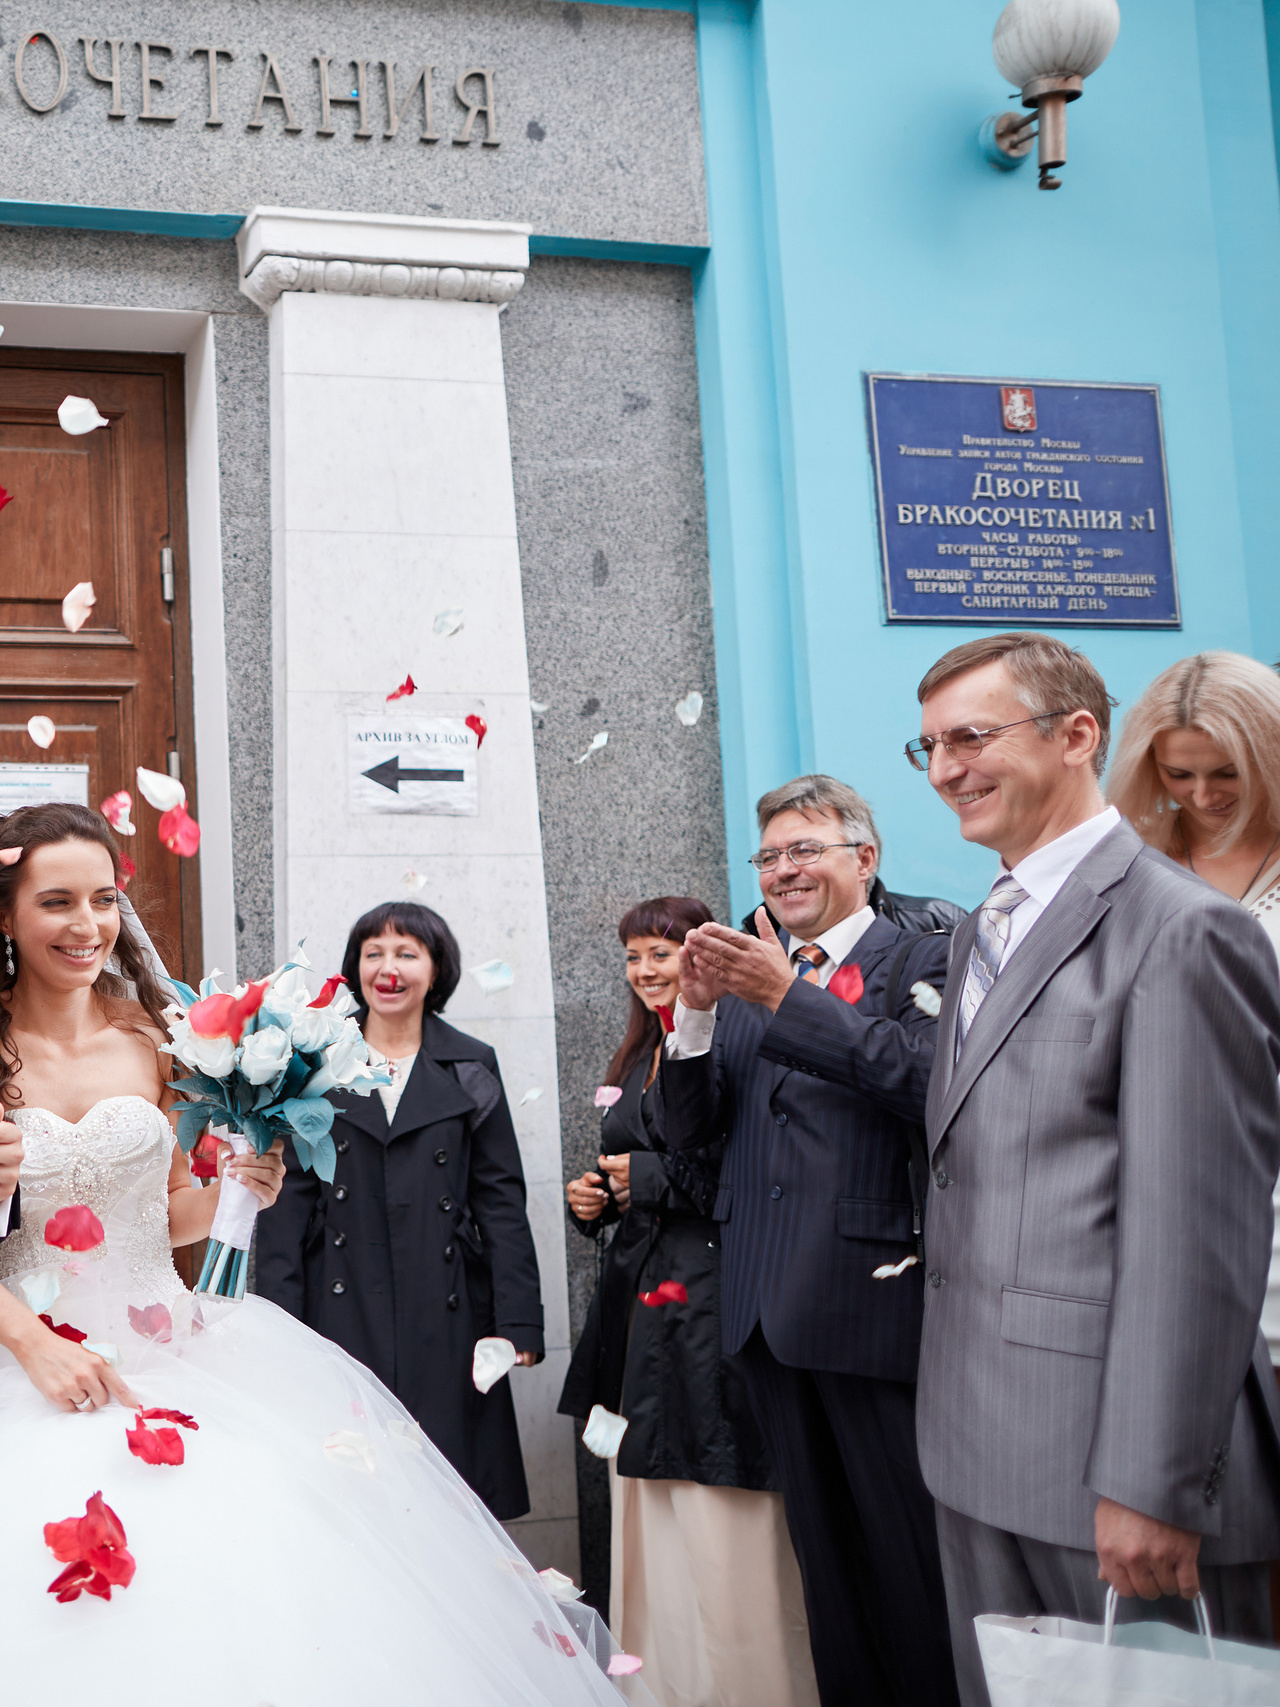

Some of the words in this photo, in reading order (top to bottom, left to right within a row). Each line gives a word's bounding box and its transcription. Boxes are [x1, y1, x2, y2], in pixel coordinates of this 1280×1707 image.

[897, 504, 1123, 530] БРАКОСОЧЕТАНИЯ
[981, 532, 1018, 543] ЧАСЫ
[1074, 572, 1157, 585] ПОНЕДЕЛЬНИК
[914, 580, 966, 593] ПЕРВЫЙ
[973, 583, 1030, 596] ВТОРНИК
[1037, 583, 1096, 597] КАЖДОГО
[961, 595, 1059, 610] САНИТАРНЫЙ
[1067, 598, 1108, 611] ДЕНЬ
[355, 732, 402, 742] АРХИВ
